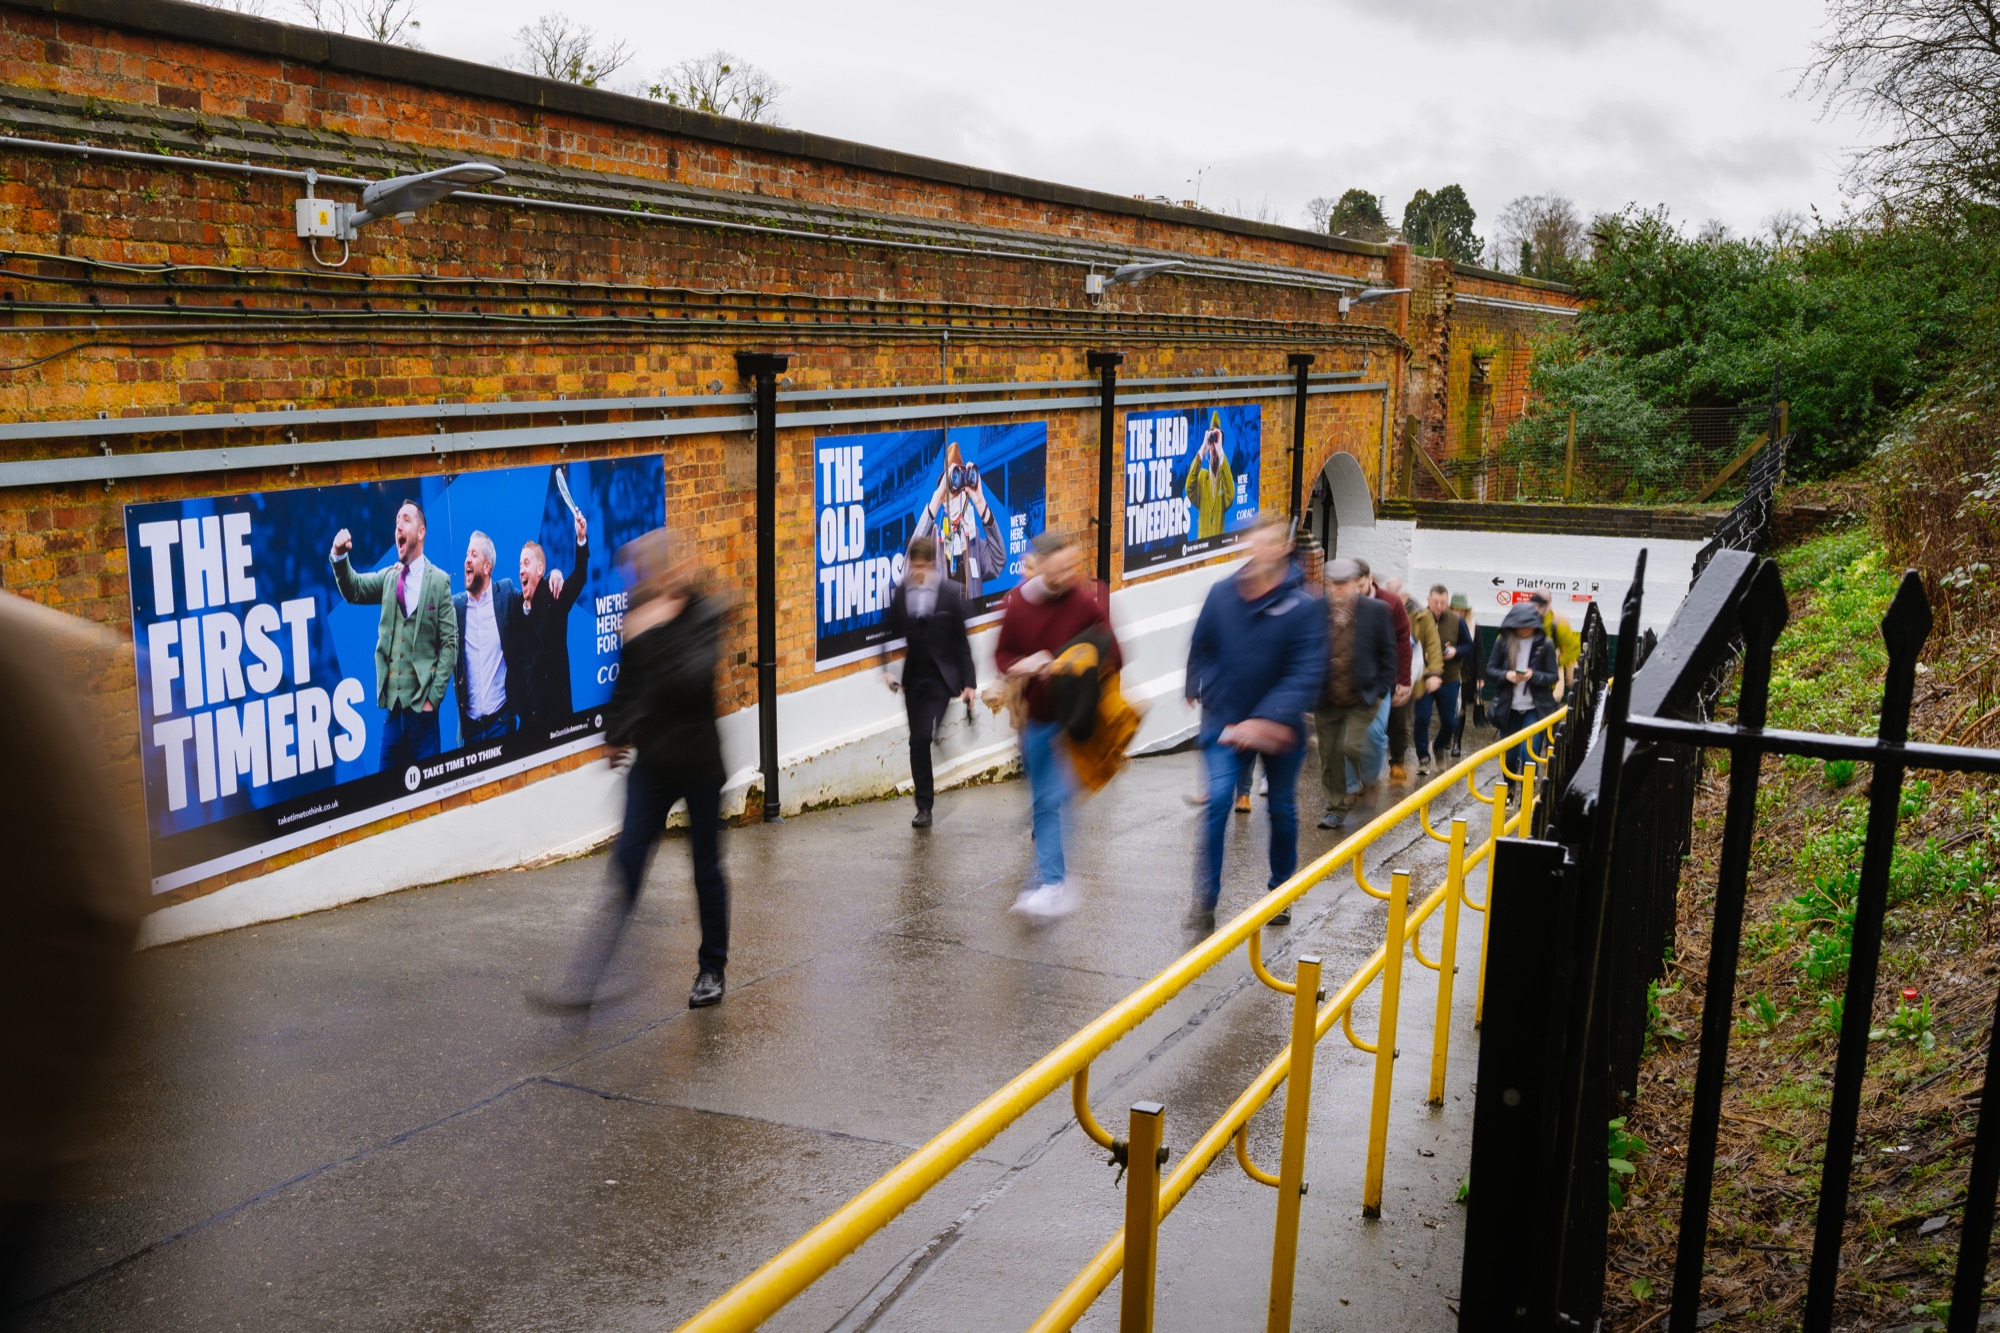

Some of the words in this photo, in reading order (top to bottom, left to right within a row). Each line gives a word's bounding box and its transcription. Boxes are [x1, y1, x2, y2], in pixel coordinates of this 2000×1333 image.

[1128, 418, 1153, 461] THE
[1156, 416, 1188, 458] HEAD
[819, 445, 864, 505] THE
[1127, 461, 1146, 504] TO
[1148, 459, 1173, 500] TOE
[1010, 513, 1027, 528] WE'RE
[1126, 496, 1192, 546] TWEEDERS
[1236, 508, 1253, 520] CORAL
[820, 504, 865, 565] OLD
[1010, 527, 1024, 541] HERE
[1010, 541, 1020, 555] FOR
[1021, 539, 1027, 552] IT
[139, 512, 257, 615] THE
[1009, 560, 1027, 575] COR
[820, 552, 905, 624] TIMERS
[1517, 578, 1566, 590] Platform
[1572, 581, 1580, 591] 2
[596, 592, 628, 615] WE'RE
[596, 613, 623, 635] HERE
[148, 597, 316, 716] FIRST
[597, 633, 618, 655] FOR
[153, 677, 366, 812] TIMERS
[423, 764, 444, 780] TAKE
[445, 757, 465, 772] TIME
[466, 753, 477, 766] TO
[478, 746, 502, 762] THINK
[277, 799, 339, 826] taketimetothink.co.uk
